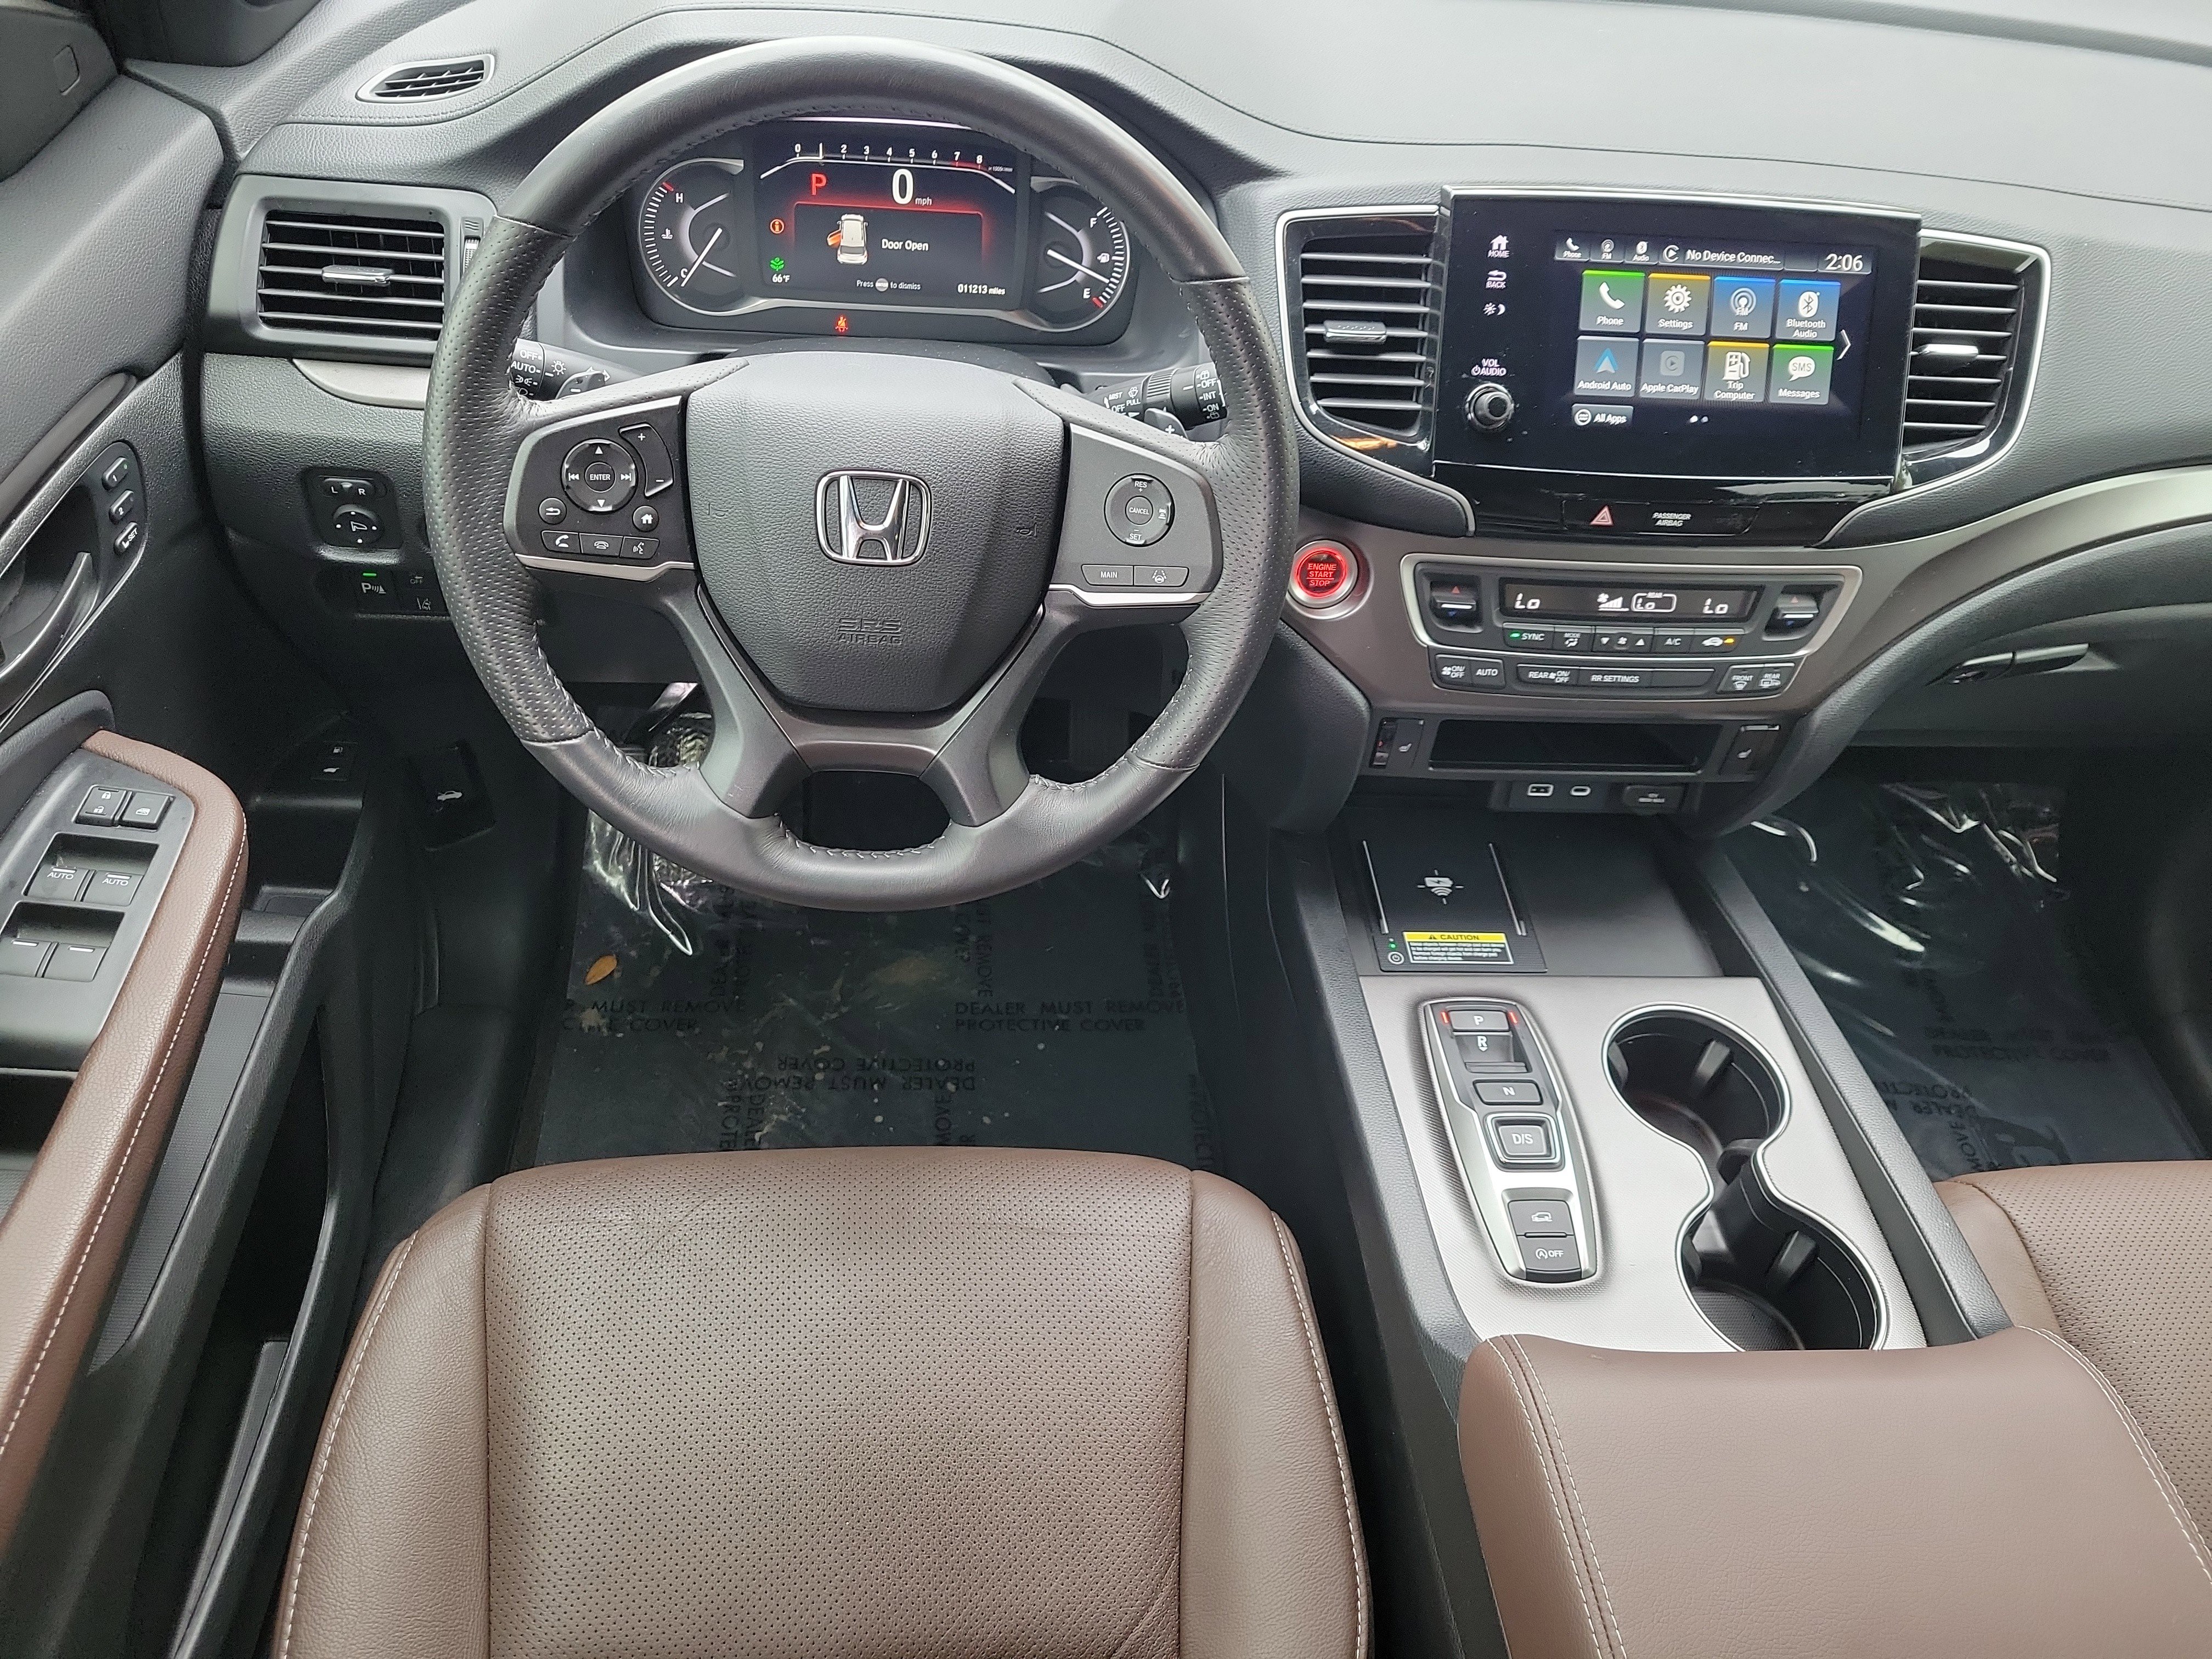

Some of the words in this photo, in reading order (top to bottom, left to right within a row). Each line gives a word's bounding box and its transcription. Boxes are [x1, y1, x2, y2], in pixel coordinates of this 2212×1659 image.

[795, 144, 801, 153] 0
[841, 144, 847, 154] 2
[864, 146, 870, 155] 3
[887, 148, 893, 156] 4
[909, 149, 915, 157] 5
[932, 150, 938, 159] 6
[954, 151, 961, 160] 7
[977, 155, 983, 163] 8
[811, 173, 827, 196] P
[891, 168, 914, 205] 0
[915, 196, 932, 206] mph
[675, 193, 683, 203] H
[1090, 217, 1097, 228] F
[882, 239, 903, 250] Door
[905, 239, 929, 252] Open
[1487, 250, 1510, 258] HOME
[1686, 251, 1701, 261] No
[1703, 251, 1735, 263] Device
[1825, 253, 1864, 271] 2:06
[680, 268, 688, 278] C
[856, 279, 873, 287] Press
[957, 284, 987, 294] 011213
[988, 286, 1006, 296] miles
[1083, 288, 1091, 298] E
[1596, 316, 1624, 326] Phone
[1658, 319, 1693, 330] Settings
[1787, 319, 1826, 329] Bluetooth
[1734, 322, 1748, 331] FM
[1792, 330, 1817, 338] Audio
[520, 349, 538, 360] OFF
[511, 360, 536, 373] AUTO
[1481, 358, 1500, 367] VOL
[1791, 362, 1812, 371] SMS
[1480, 367, 1506, 376] AUDIO
[1201, 377, 1217, 388] OFF
[1577, 381, 1610, 391] Android
[1611, 382, 1632, 391] Auto
[1726, 381, 1743, 391] Trip
[1640, 383, 1666, 393] Apple
[1667, 384, 1699, 396] CarPlay
[1778, 388, 1820, 399] Messages
[1109, 392, 1123, 400] MIST
[1203, 391, 1216, 401] INT
[1714, 390, 1755, 401] Computer
[1126, 398, 1141, 407] PULL
[1206, 403, 1220, 412] ON
[1111, 403, 1125, 413] OFF
[1594, 413, 1605, 422] All
[1606, 414, 1627, 425] Apps
[119, 507, 124, 516] 2
[1129, 506, 1149, 515] CANCEL
[1652, 512, 1691, 520] PASSENGER
[128, 527, 138, 541] SET
[1514, 592, 1541, 609] Lo
[1636, 598, 1656, 610] Lo
[1703, 598, 1728, 614] Lo
[839, 618, 902, 633] SRS
[839, 633, 902, 645] AIRBAG
[1522, 633, 1545, 642] SYNC
[1664, 637, 1681, 646] A/C
[47, 872, 75, 880] AUTO
[102, 878, 129, 887] AUTO
[591, 1000, 647, 1014] MUST
[955, 1001, 1026, 1015] DEALER
[1040, 1001, 1093, 1015] MUST
[1105, 999, 1185, 1014] REMOVE
[630, 1018, 698, 1032] COVER
[955, 1018, 1070, 1032] PROTECTIVE
[1080, 1018, 1146, 1031] COVER
[1474, 1015, 1484, 1025] P
[1477, 1035, 1487, 1047] R
[777, 1054, 845, 1071] COVER
[856, 1057, 975, 1073] PROTECTIVE
[828, 1076, 887, 1091] MUST
[902, 1076, 977, 1091] DEALER
[1502, 1086, 1516, 1096] N
[1512, 1133, 1534, 1146] D/S
[1548, 1249, 1565, 1259] OFF
